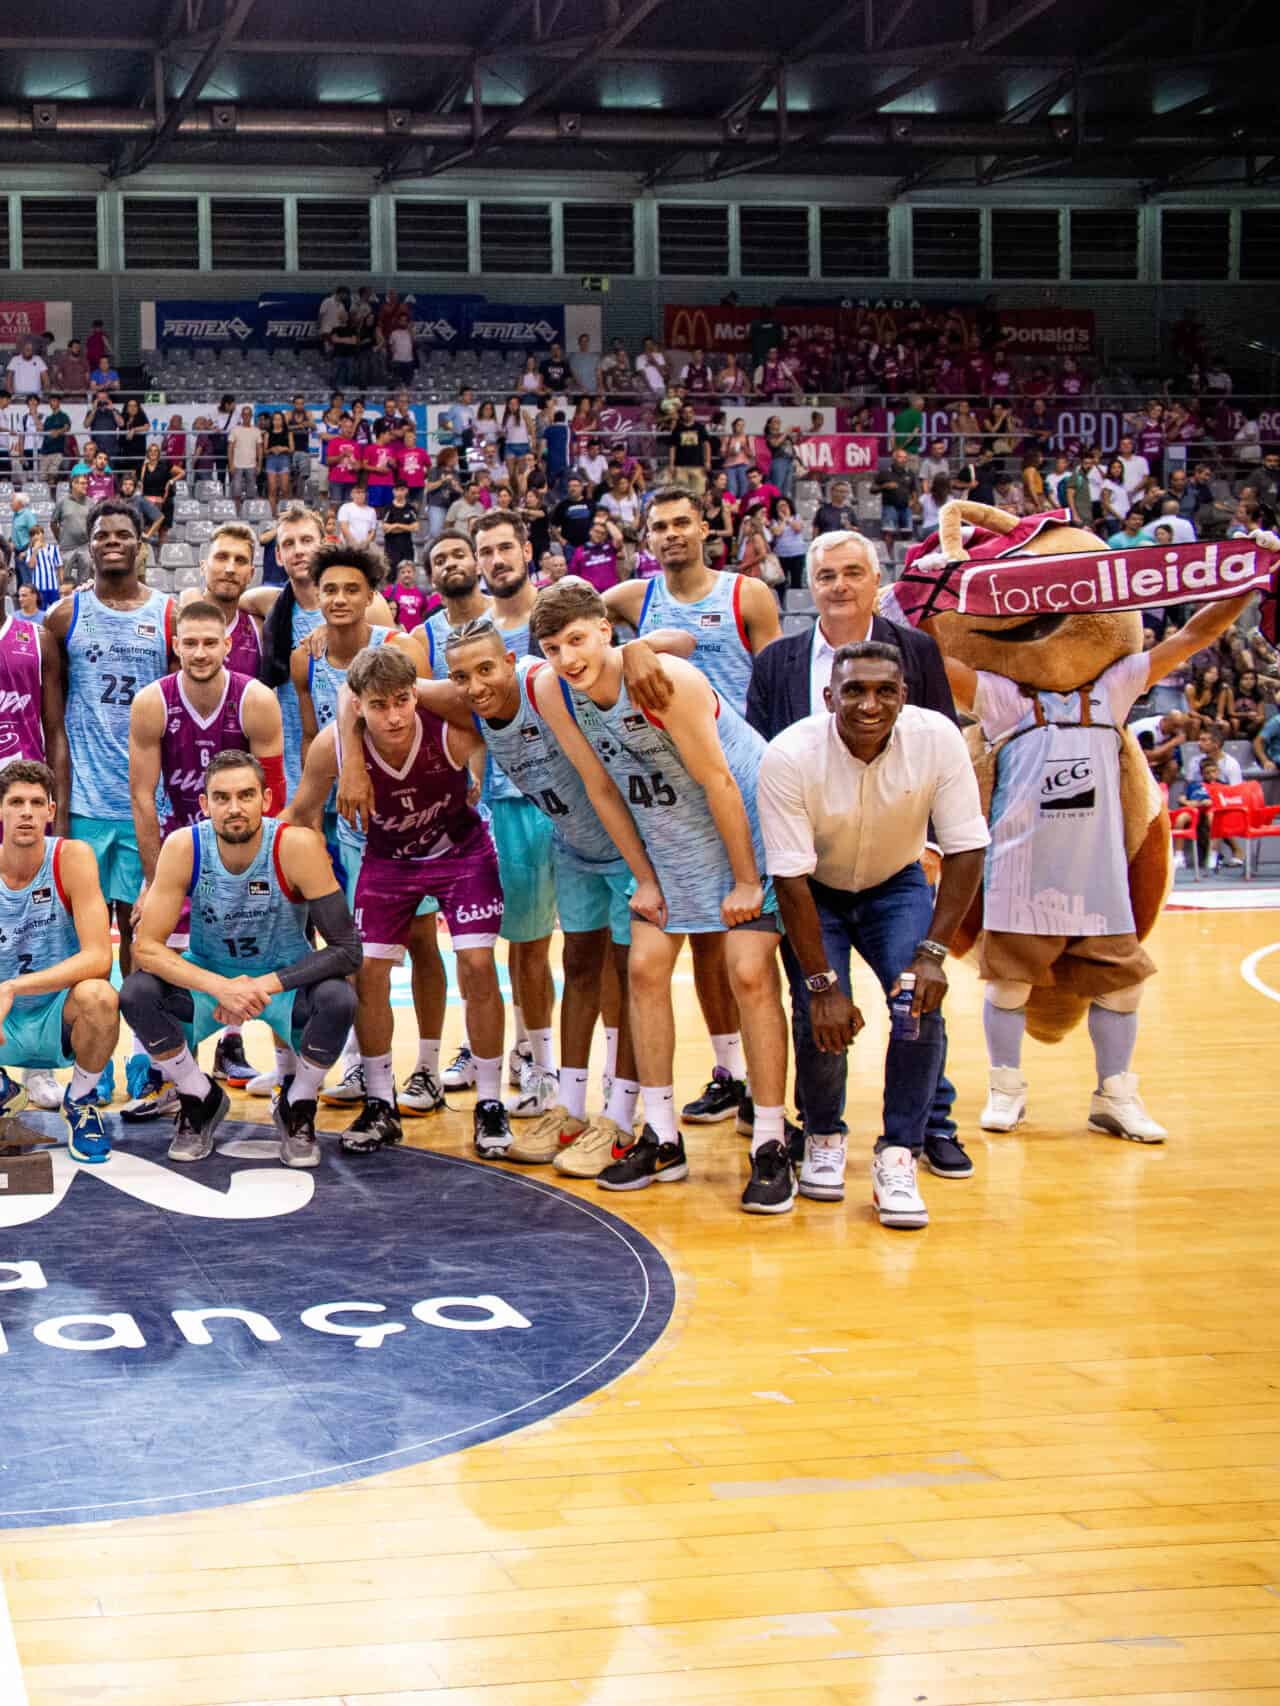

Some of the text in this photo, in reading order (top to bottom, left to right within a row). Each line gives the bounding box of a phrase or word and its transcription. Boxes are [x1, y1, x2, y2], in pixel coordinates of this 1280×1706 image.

[265, 319, 320, 337] PENTE
[1006, 327, 1089, 343] Donald's
[101, 673, 137, 706] 23
[200, 748, 210, 768] 6
[1046, 761, 1090, 791] ICG
[628, 770, 678, 809] 45
[401, 796, 414, 811] 4
[354, 907, 364, 930] 4
[222, 936, 260, 958] 13
